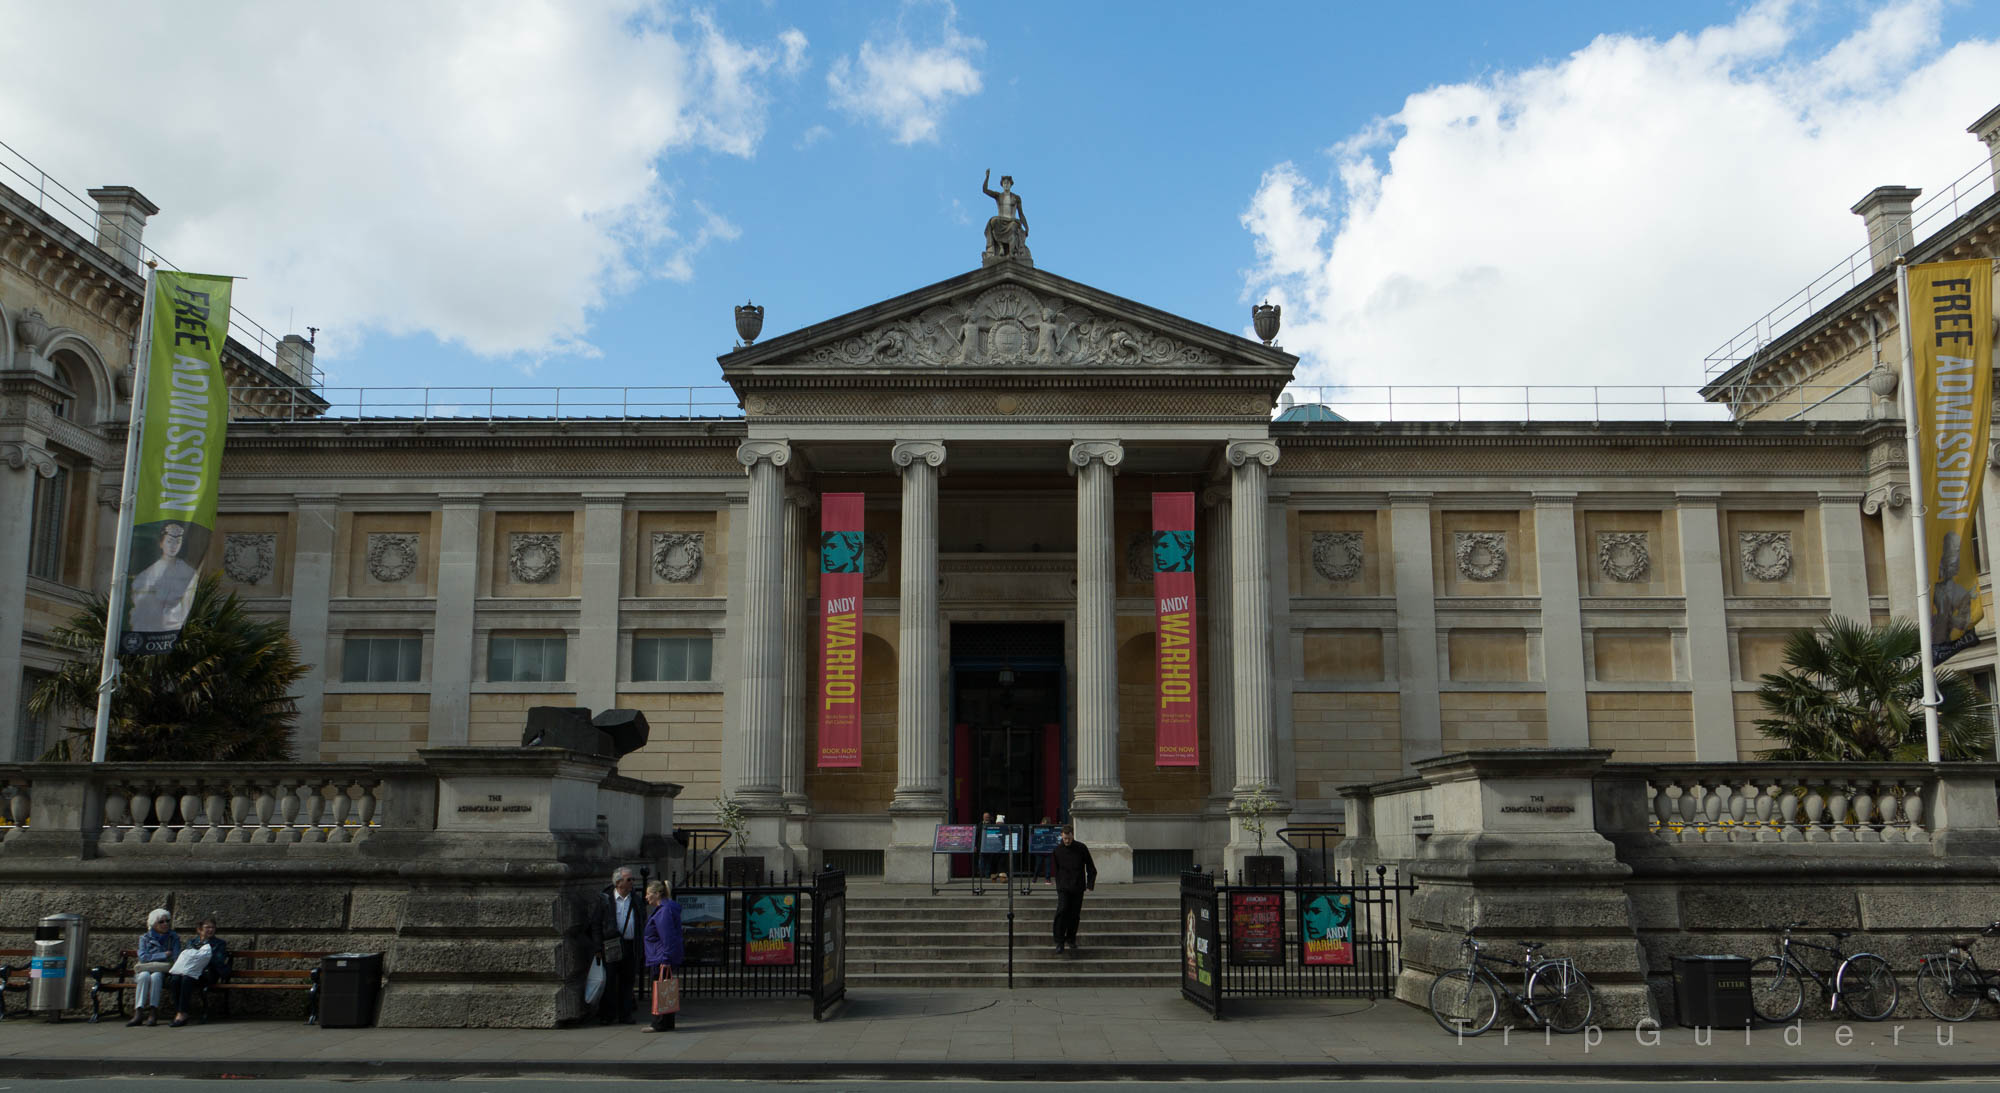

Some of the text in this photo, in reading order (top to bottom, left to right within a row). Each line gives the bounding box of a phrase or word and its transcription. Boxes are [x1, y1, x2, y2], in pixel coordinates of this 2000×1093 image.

[160, 285, 211, 512] FREE ADMISSION
[1932, 278, 1975, 520] FREE ADMISSION
[827, 596, 856, 614] ANDY
[1161, 595, 1189, 613] ANDY
[825, 613, 856, 710] WARHOL
[1160, 612, 1191, 709] WARHOL
[769, 925, 792, 939] ANDY
[1326, 926, 1349, 939] ANDY
[750, 938, 787, 953] WARHOL
[1308, 938, 1344, 953] WARHOL
